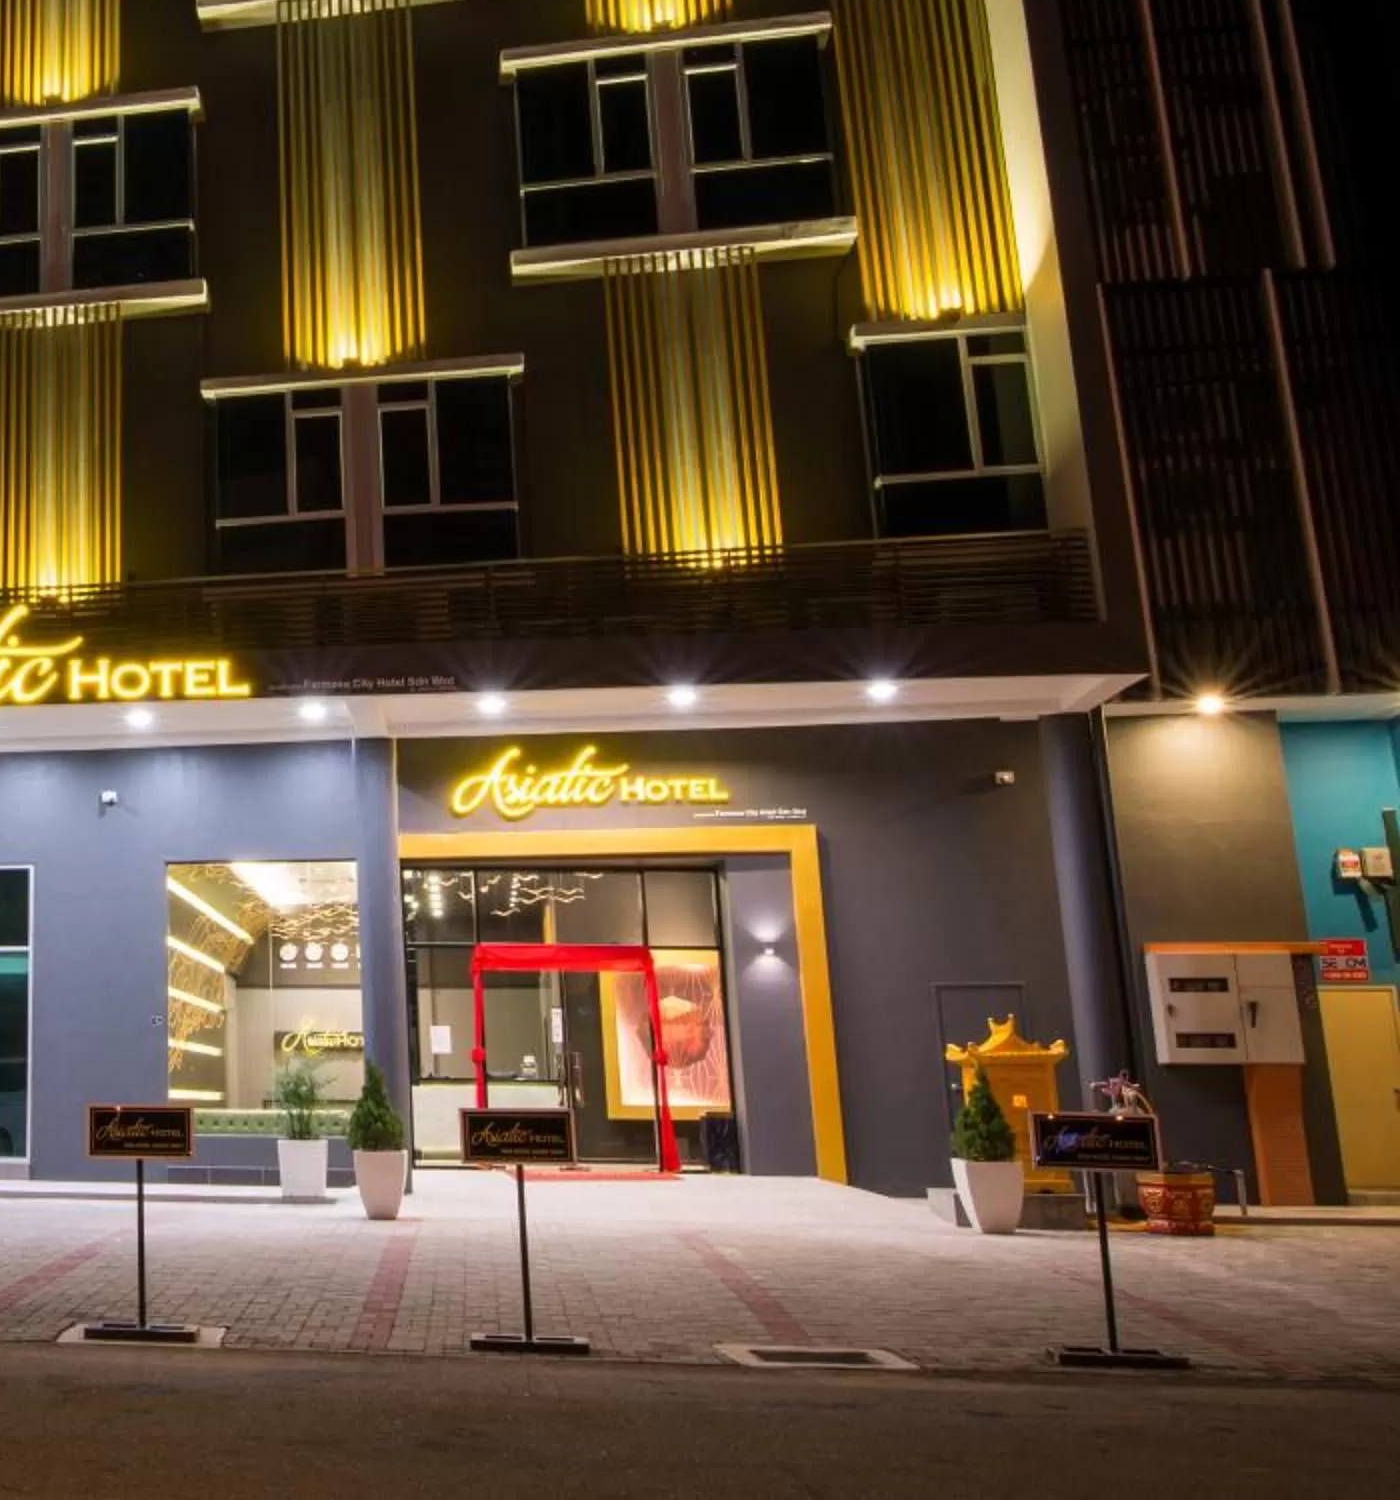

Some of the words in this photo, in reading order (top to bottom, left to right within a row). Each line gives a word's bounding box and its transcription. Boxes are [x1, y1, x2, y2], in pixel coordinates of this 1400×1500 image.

[68, 659, 250, 699] HOTEL
[451, 745, 630, 821] Asiatic
[620, 777, 730, 804] HOTEL
